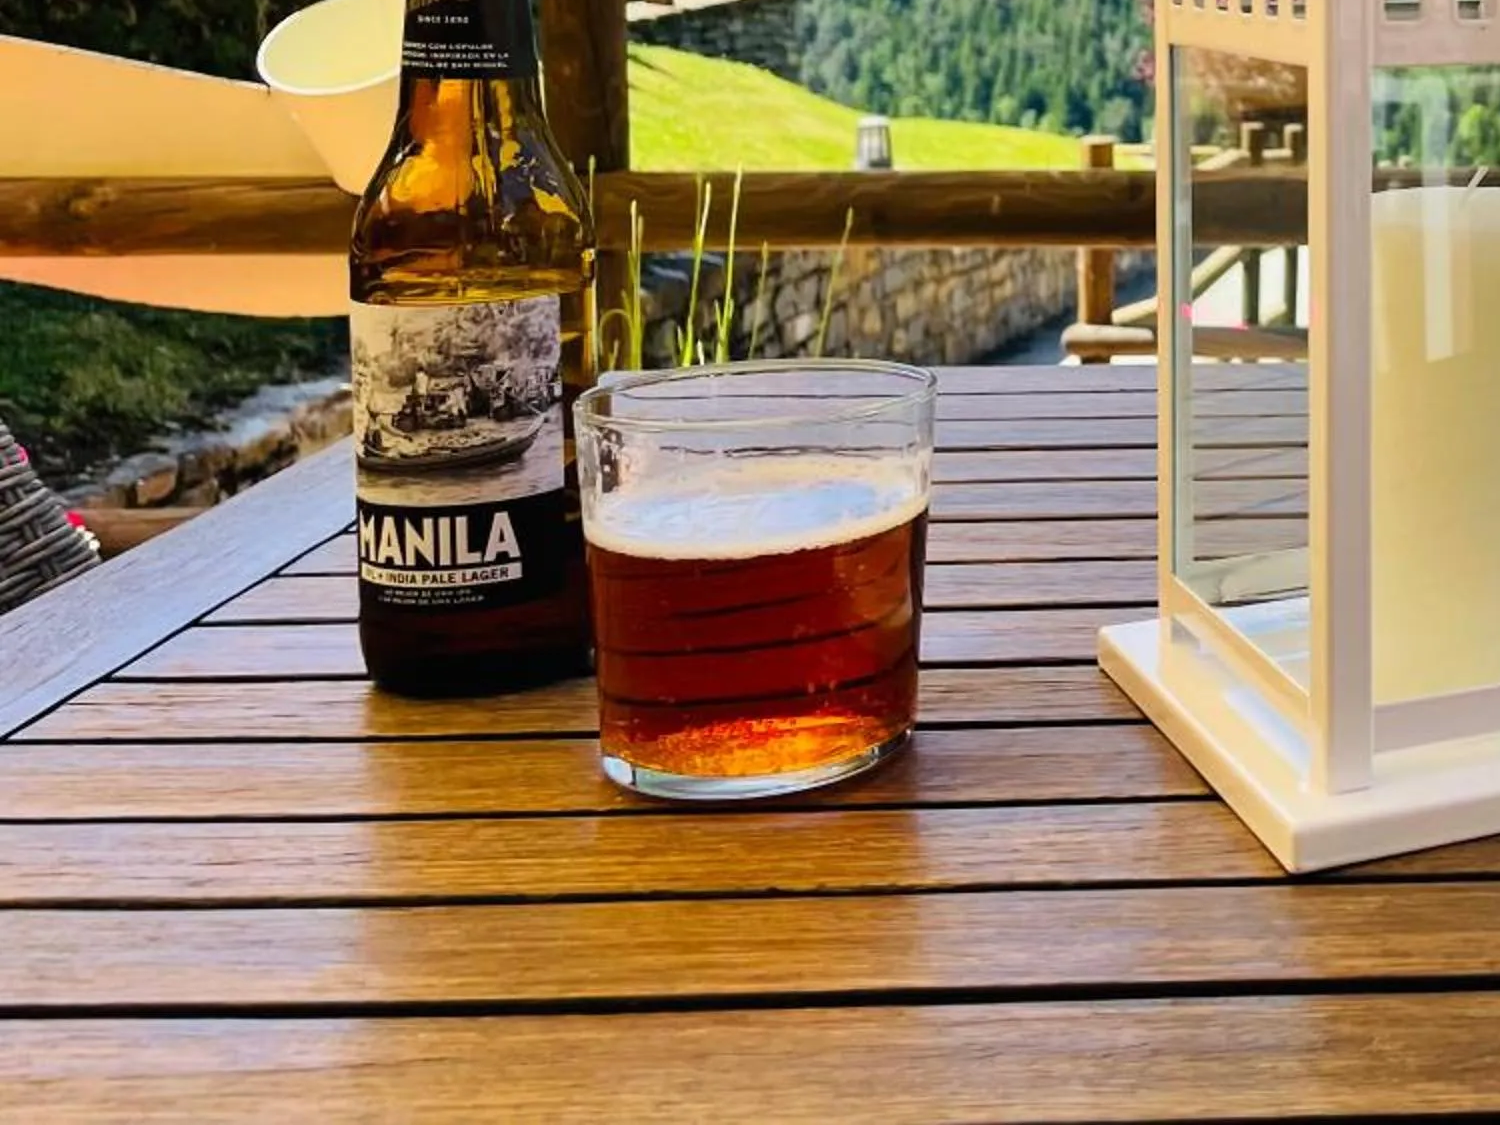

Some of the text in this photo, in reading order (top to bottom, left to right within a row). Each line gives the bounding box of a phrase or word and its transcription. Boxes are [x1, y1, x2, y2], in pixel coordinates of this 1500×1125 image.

[360, 510, 521, 567] MANILA
[386, 572, 419, 585] INDIA
[421, 572, 457, 585] PALE
[462, 566, 509, 584] LAGER
